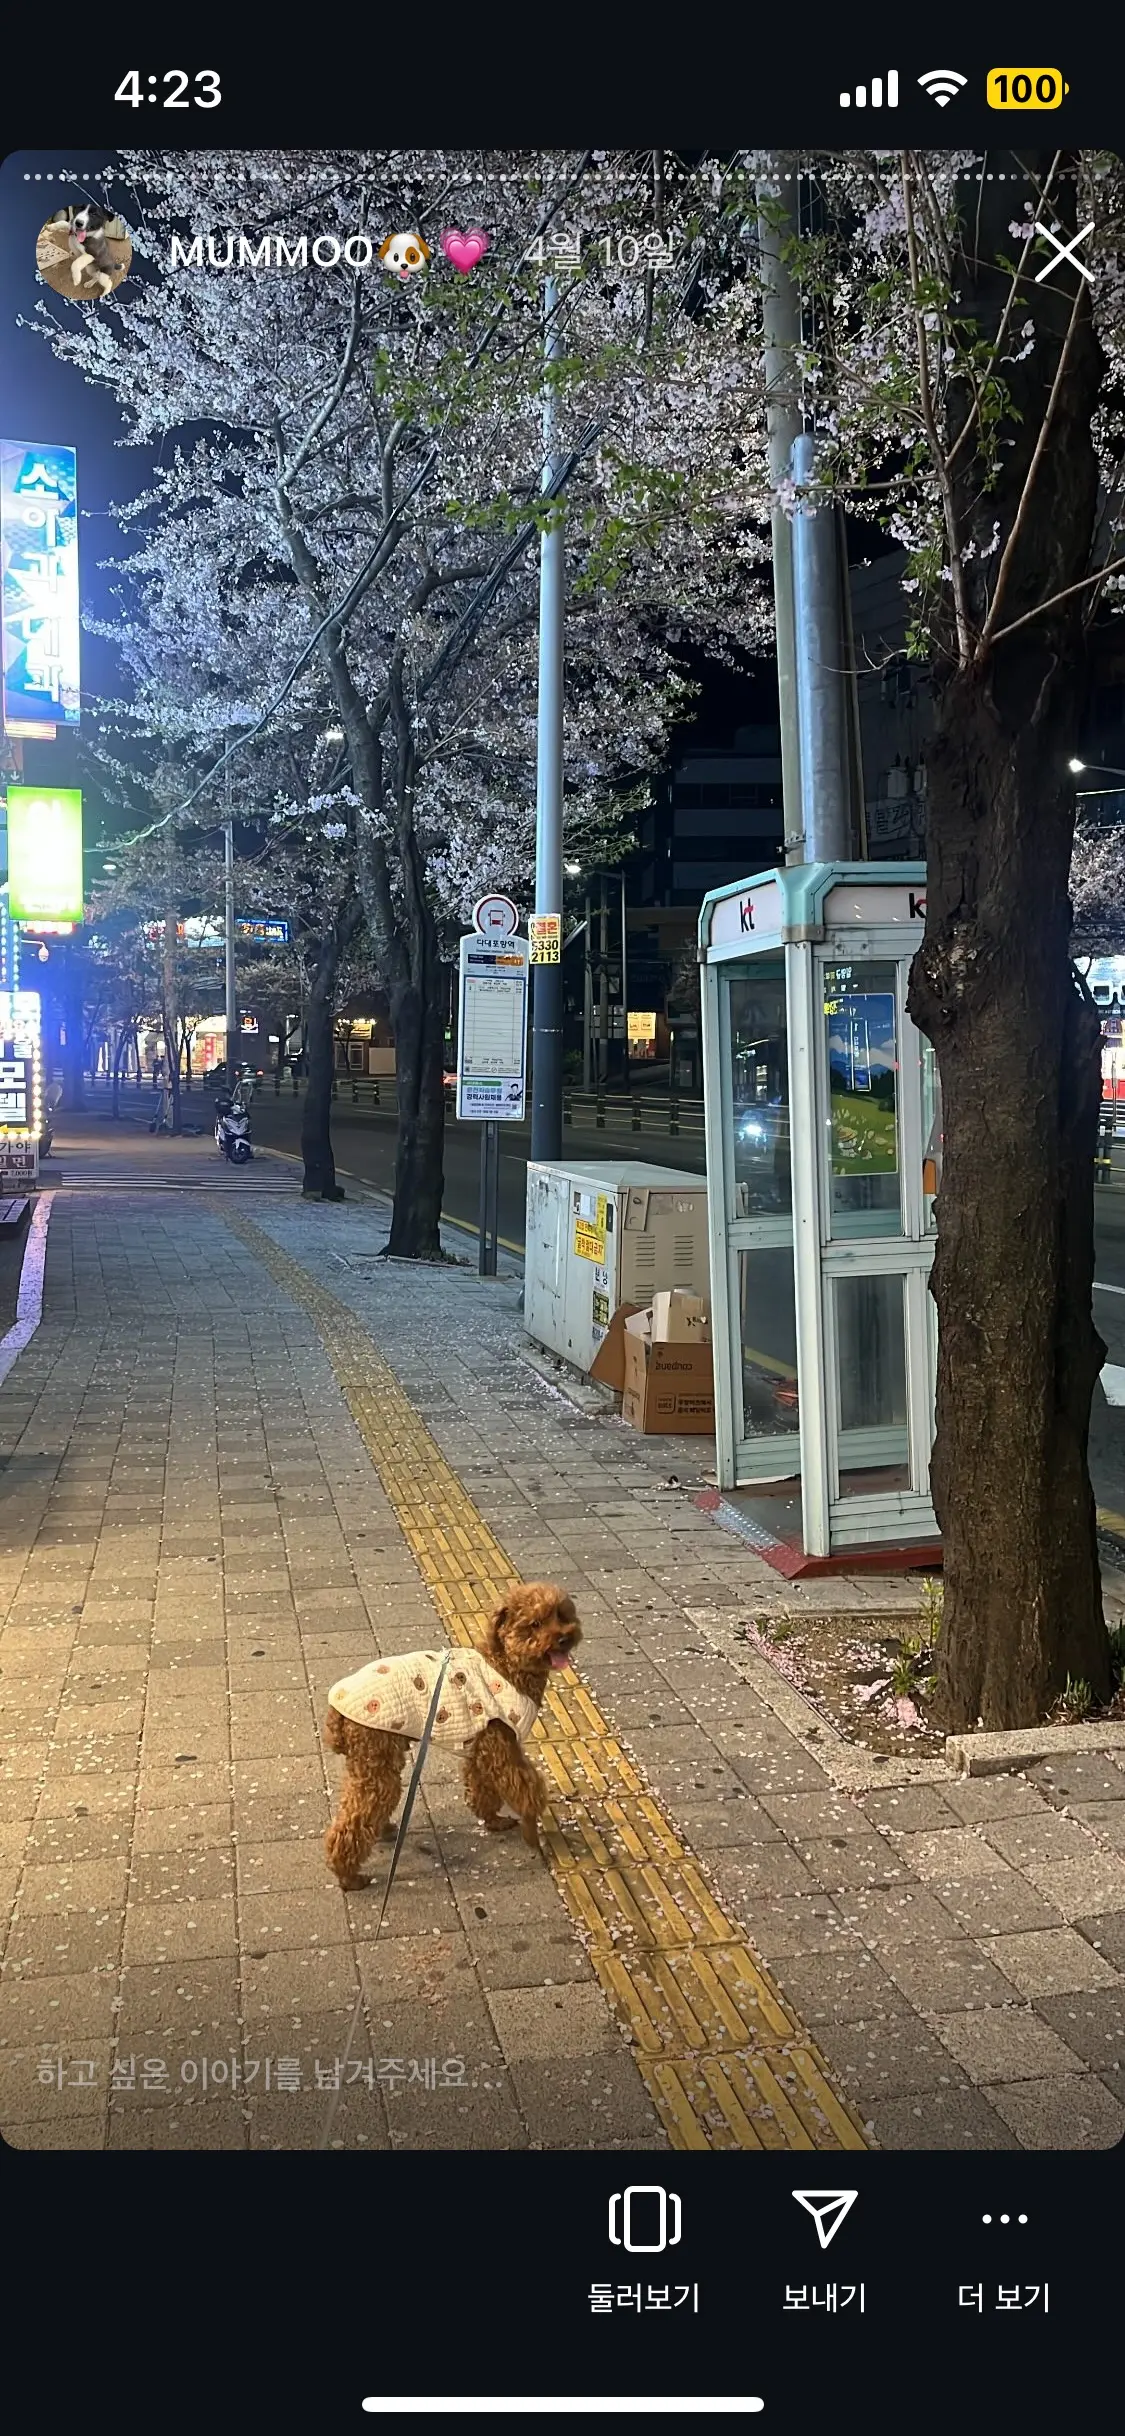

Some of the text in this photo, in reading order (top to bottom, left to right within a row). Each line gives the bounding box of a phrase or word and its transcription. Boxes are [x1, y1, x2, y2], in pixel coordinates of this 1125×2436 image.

[739, 897, 755, 933] kt
[909, 892, 928, 919] k
[531, 951, 559, 963] 2113
